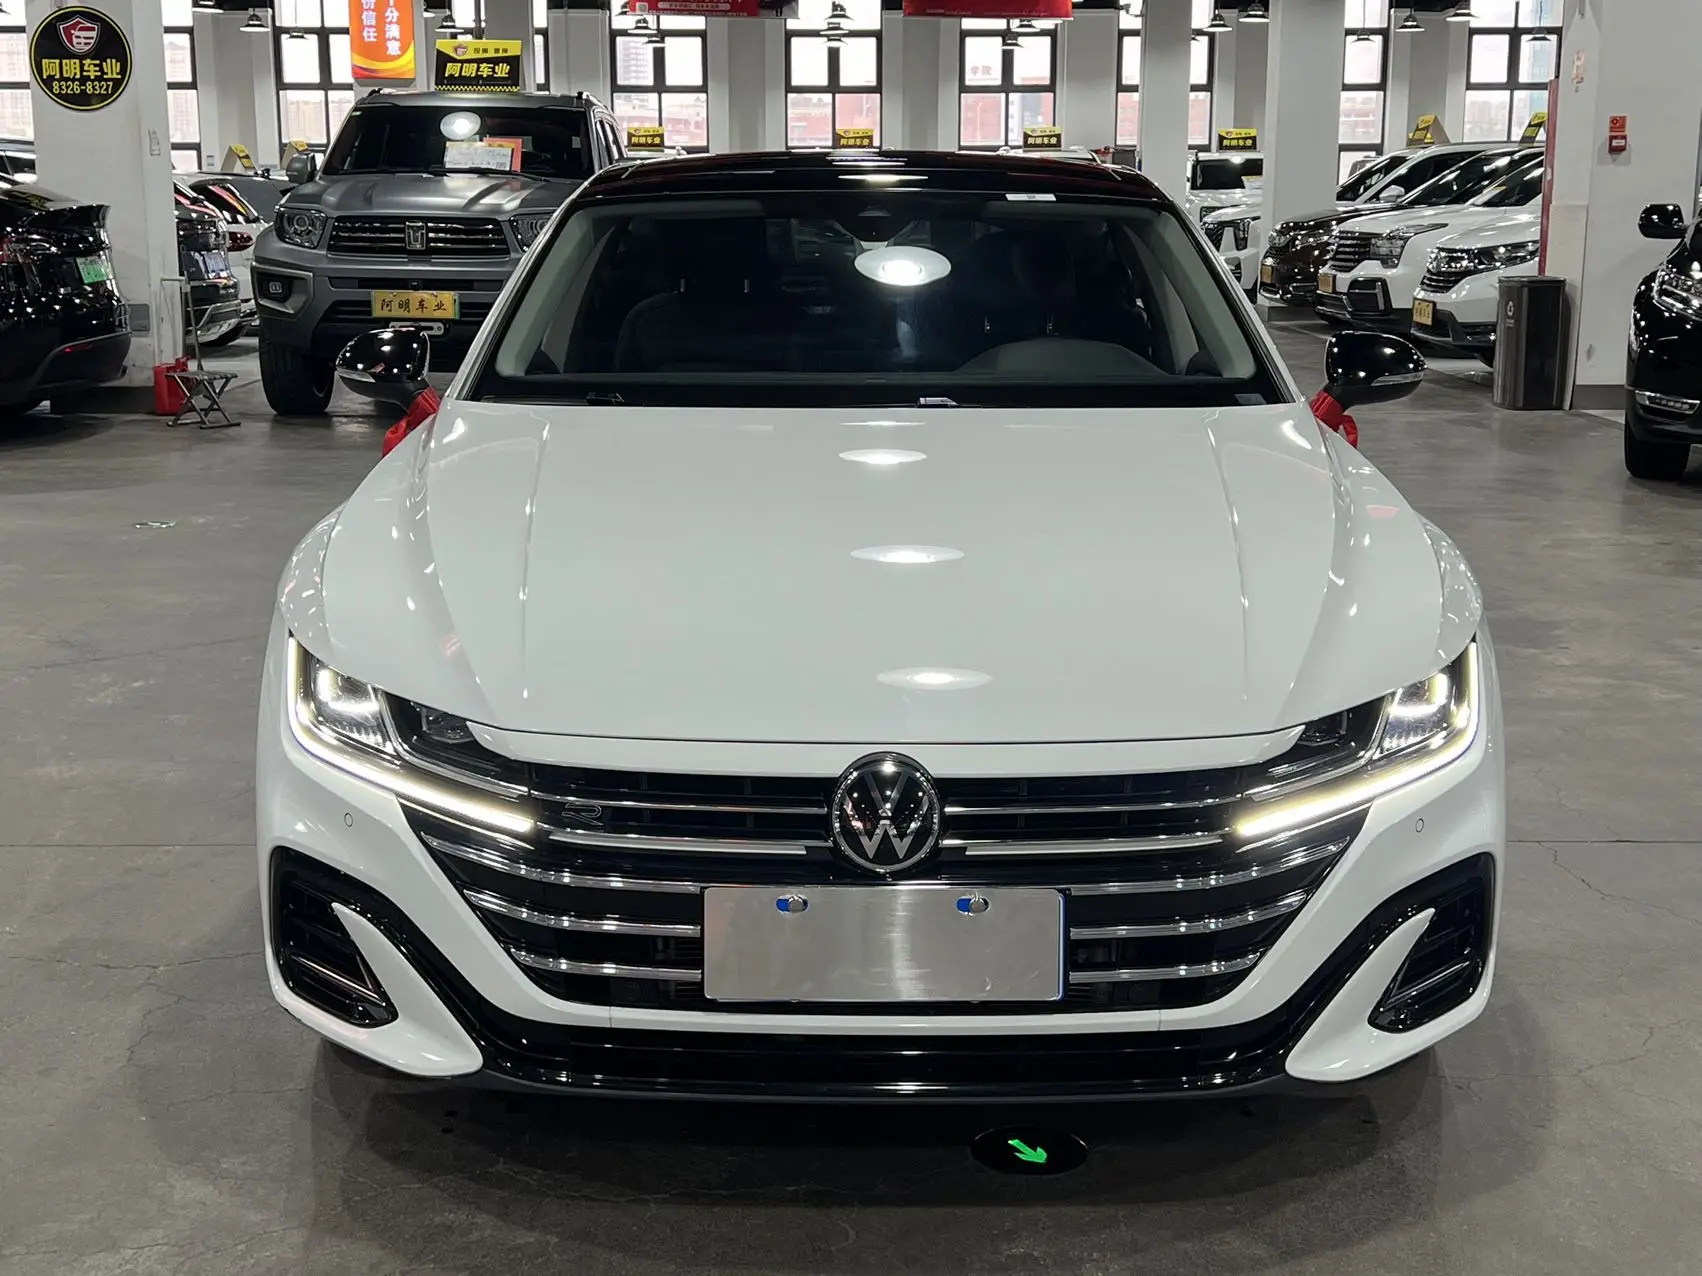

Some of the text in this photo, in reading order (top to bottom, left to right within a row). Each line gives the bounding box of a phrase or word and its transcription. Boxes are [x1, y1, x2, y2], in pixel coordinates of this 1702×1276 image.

[41, 58, 122, 79] 阿明车业
[444, 62, 511, 78] 阿明车业
[52, 81, 113, 94] 8326-8327
[380, 298, 447, 313] 阿明车业
[839, 764, 932, 863] VW
